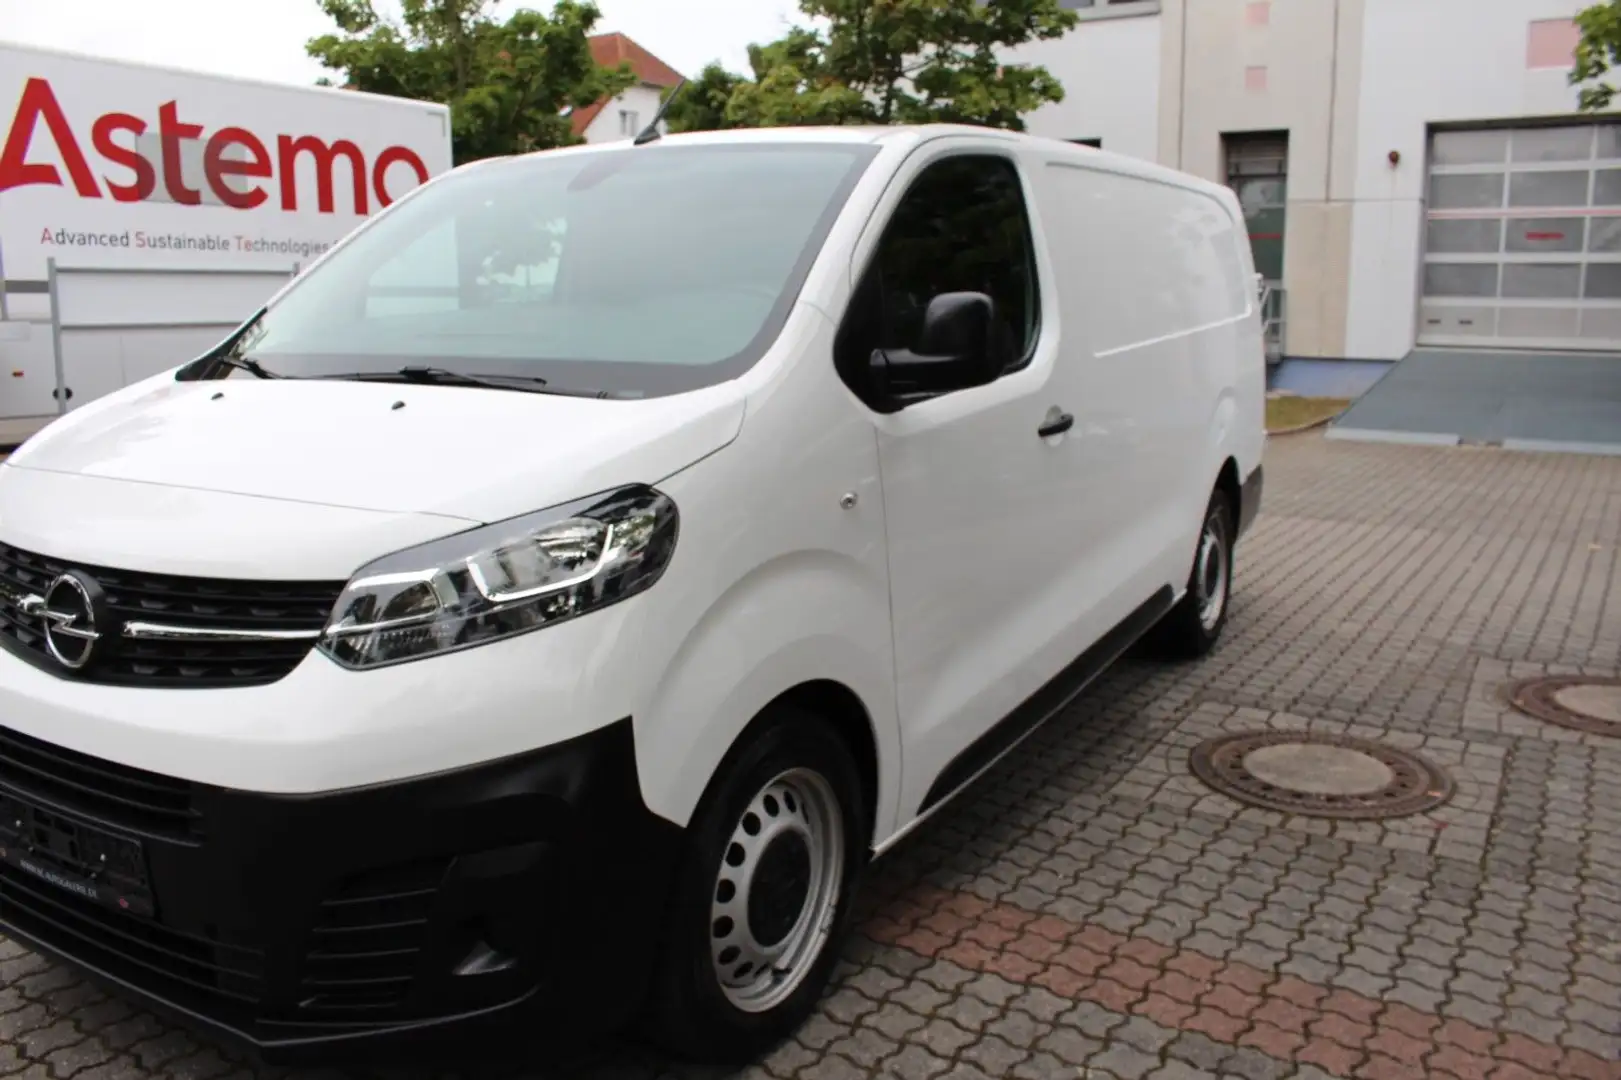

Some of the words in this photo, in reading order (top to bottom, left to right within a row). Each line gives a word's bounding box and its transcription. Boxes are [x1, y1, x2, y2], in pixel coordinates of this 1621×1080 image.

[0, 77, 429, 216] Astemo
[40, 227, 130, 248] Advanced
[135, 231, 230, 251] Sustainable
[234, 235, 329, 257] Technologies
